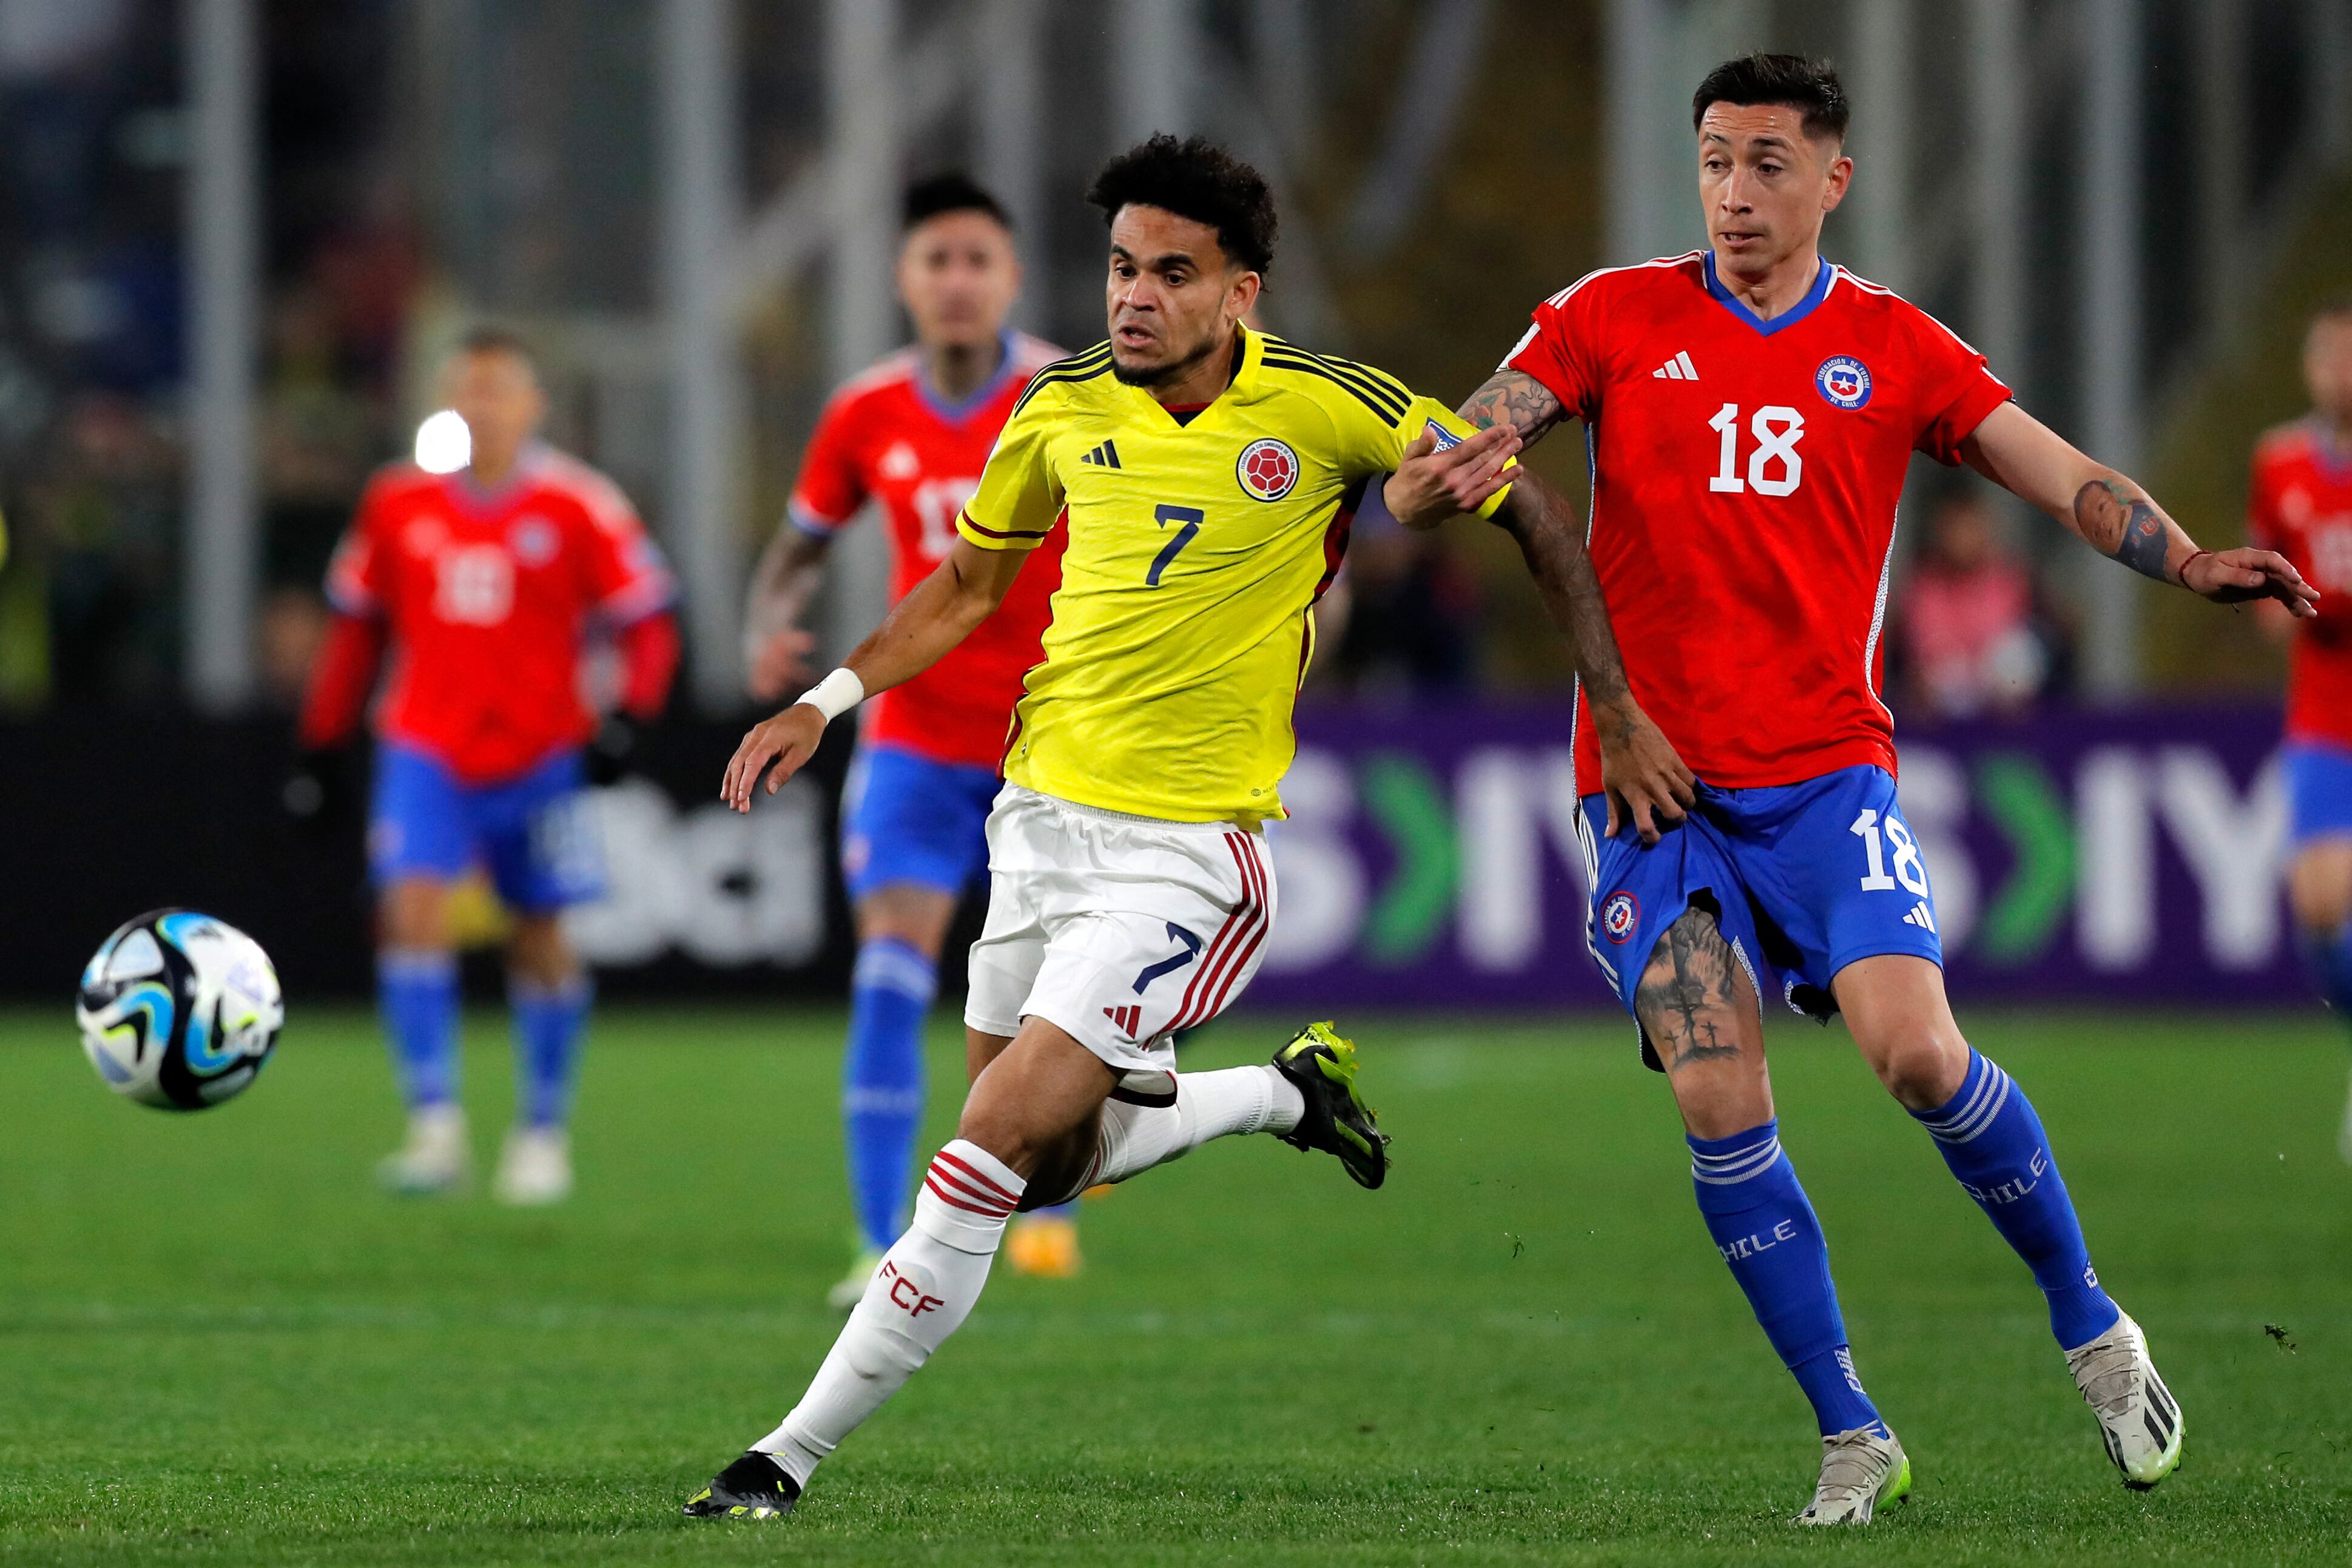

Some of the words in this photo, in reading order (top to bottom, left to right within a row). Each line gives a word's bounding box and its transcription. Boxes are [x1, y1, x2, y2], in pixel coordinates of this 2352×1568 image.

[1817, 358, 1845, 380] FEDERACION
[1858, 367, 1870, 388] FUTBOL
[1708, 403, 1805, 497] 18
[1145, 504, 1204, 586] 7
[1850, 809, 1928, 898] 18
[1132, 921, 1201, 995] 7
[1958, 1147, 2048, 1204] CHILE
[1719, 1219, 1796, 1262] HILE
[879, 1260, 945, 1317] FCF
